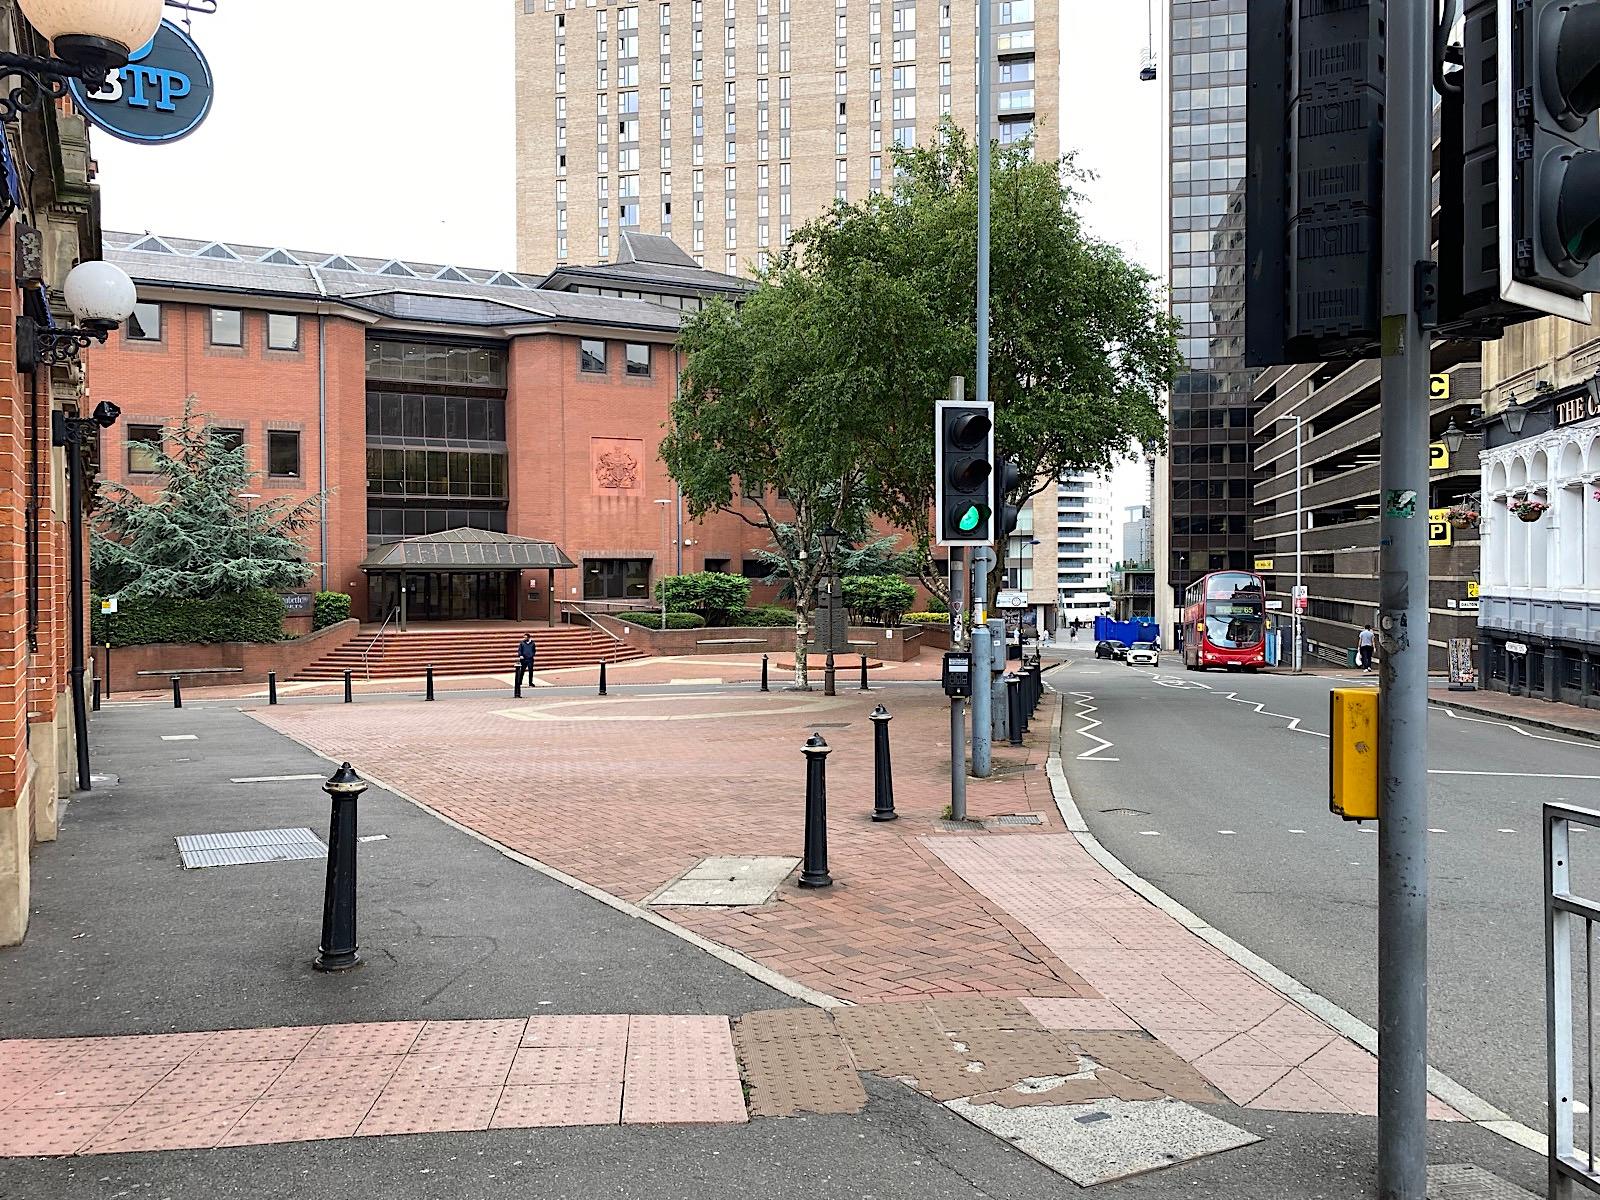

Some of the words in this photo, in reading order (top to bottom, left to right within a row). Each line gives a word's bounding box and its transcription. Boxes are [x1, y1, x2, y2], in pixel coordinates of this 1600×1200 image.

[87, 64, 191, 111] BTP
[1556, 396, 1586, 425] THE
[1430, 524, 1444, 539] P
